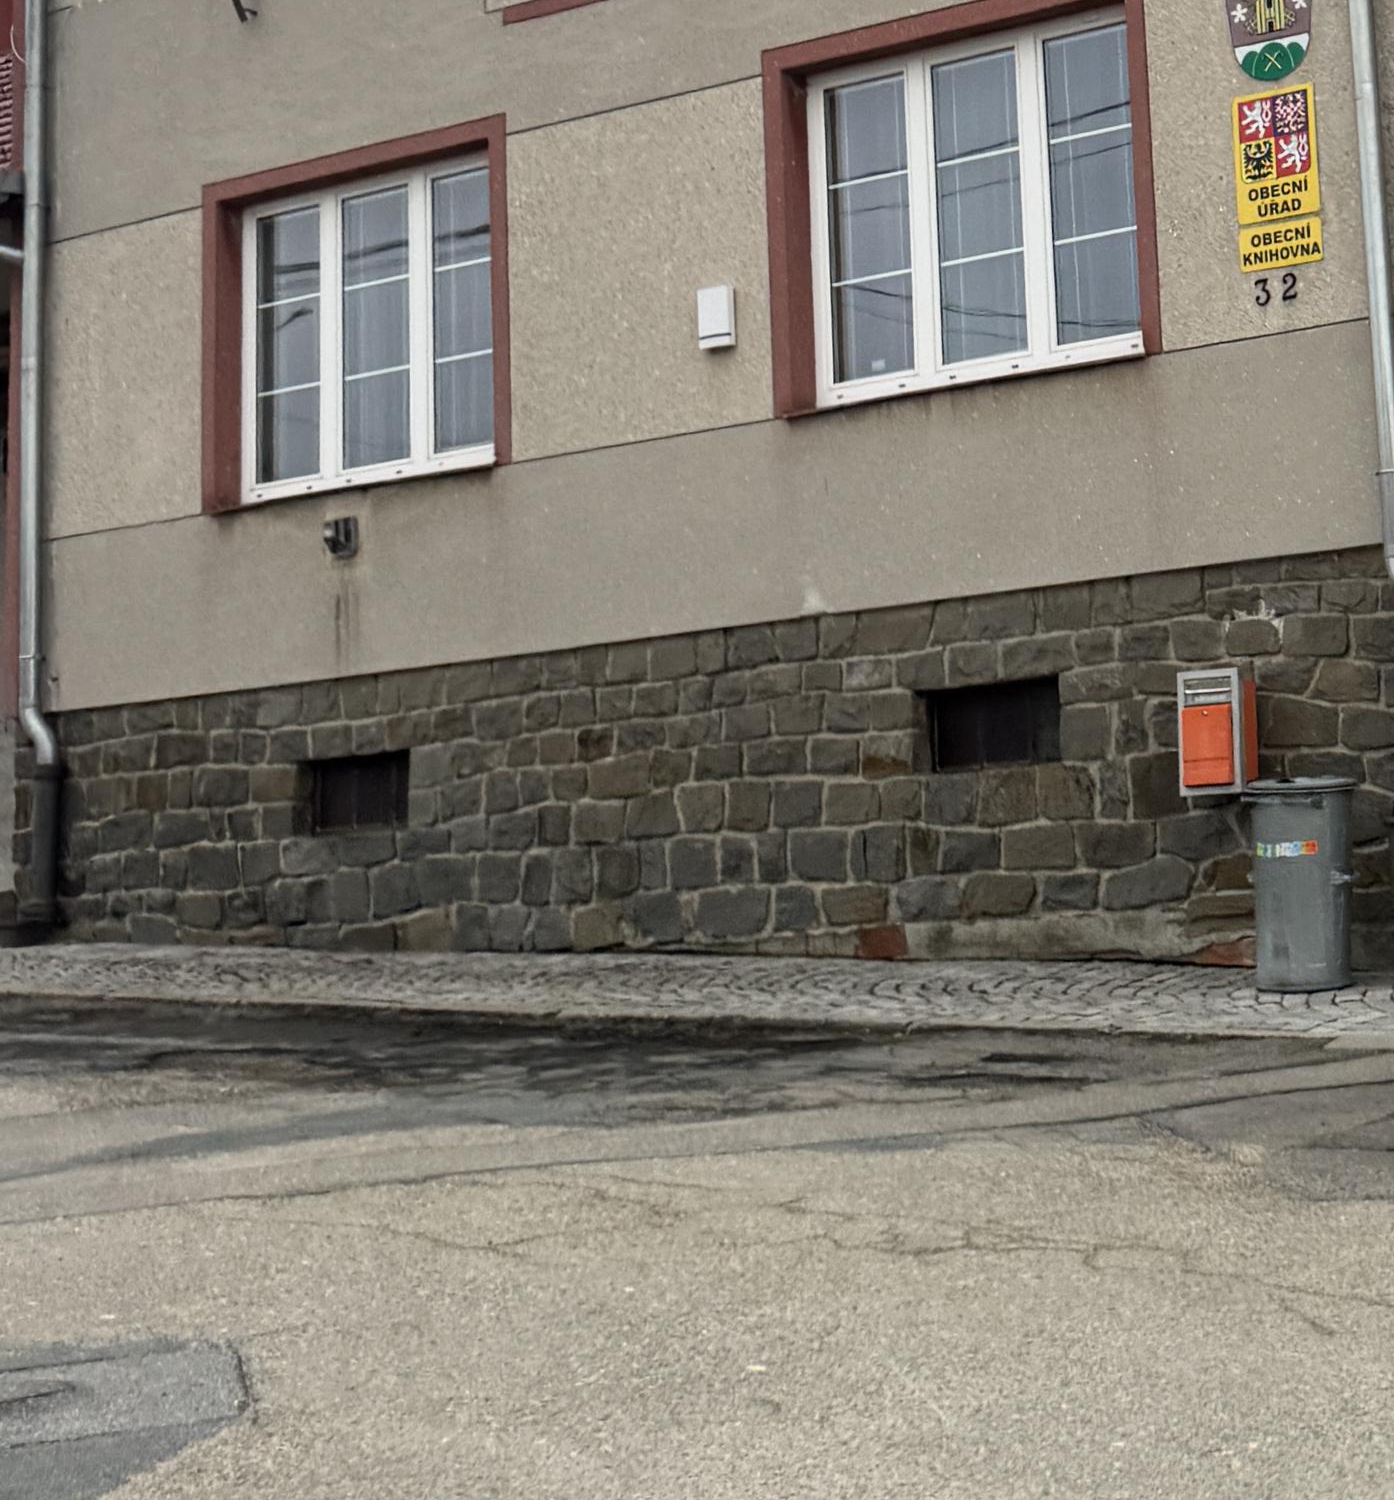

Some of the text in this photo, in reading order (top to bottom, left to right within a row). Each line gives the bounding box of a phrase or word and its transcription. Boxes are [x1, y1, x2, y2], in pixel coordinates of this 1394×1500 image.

[1248, 175, 1308, 201] OBECNÍ
[1257, 198, 1302, 217] ÚŘAD
[1251, 222, 1311, 247] OBECNÍ
[1243, 242, 1321, 267] KNIHOVNA
[1254, 273, 1298, 306] 32
